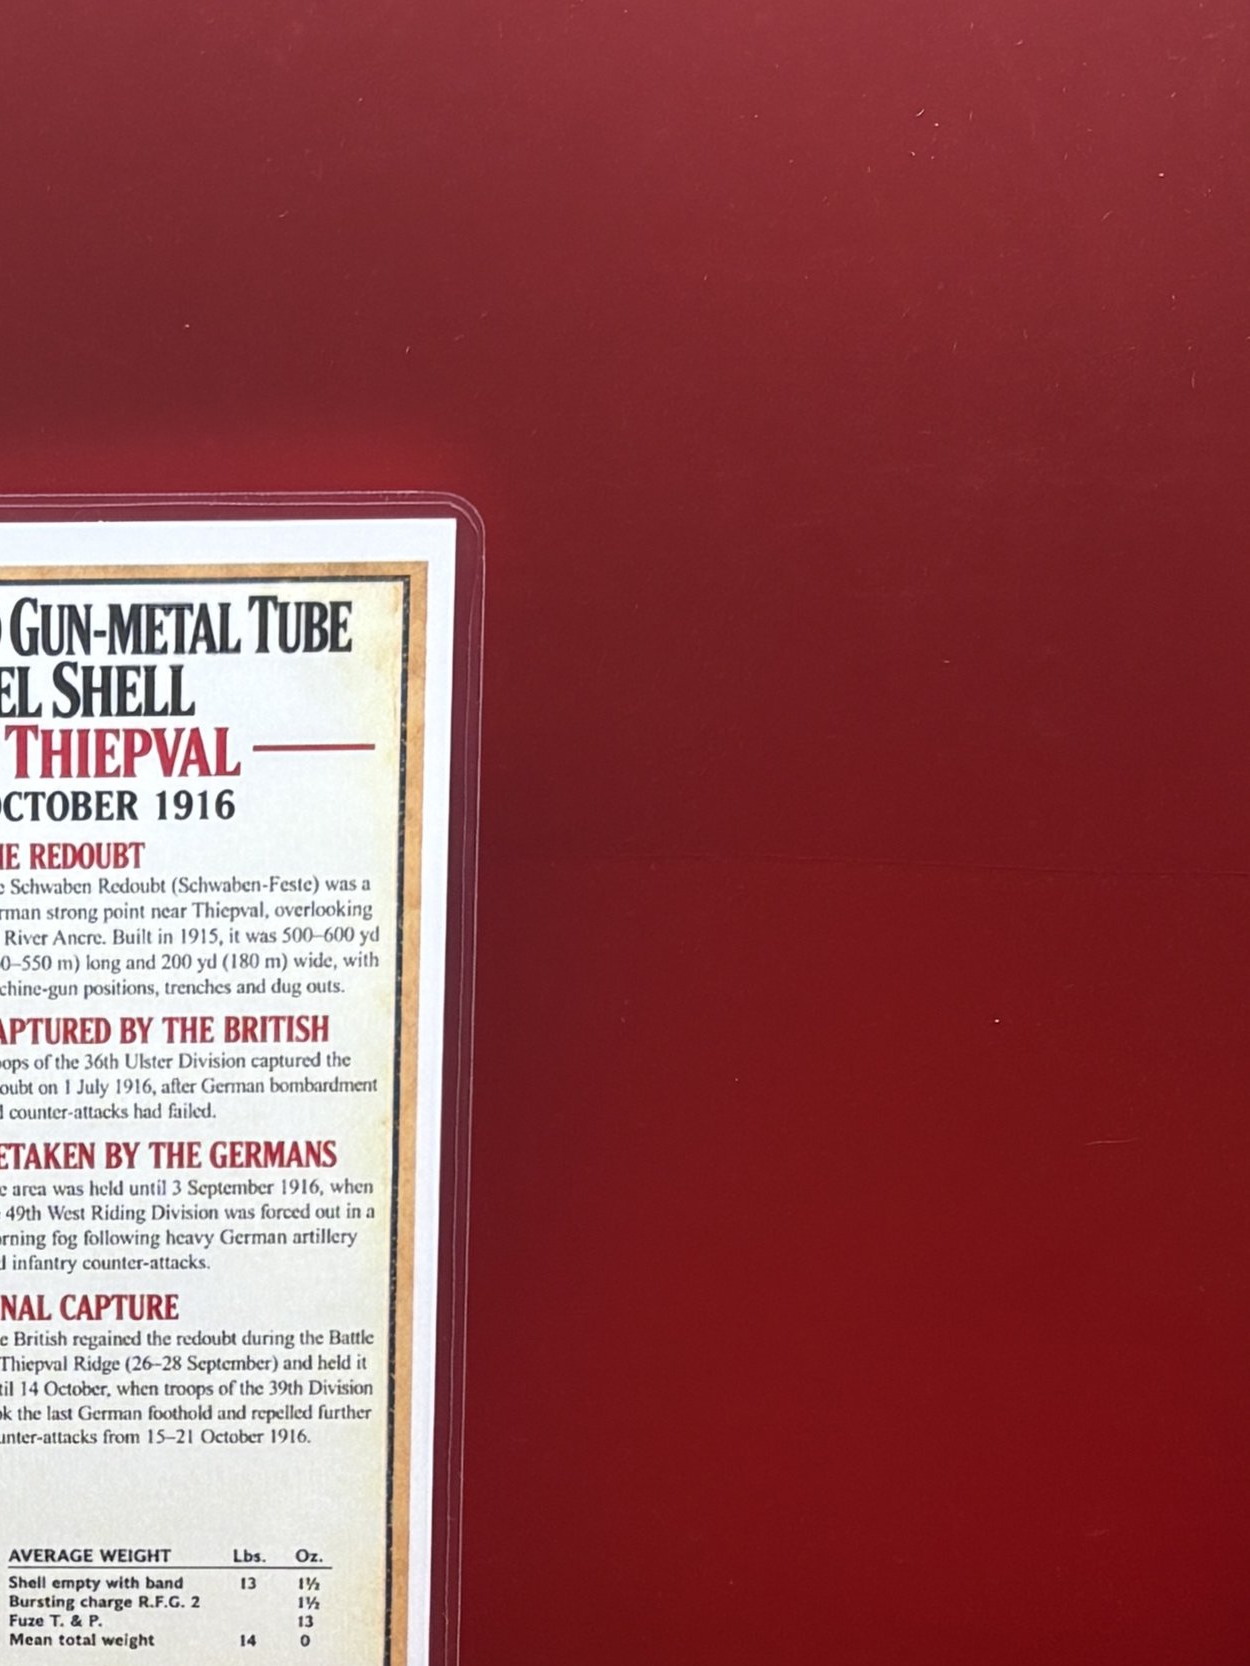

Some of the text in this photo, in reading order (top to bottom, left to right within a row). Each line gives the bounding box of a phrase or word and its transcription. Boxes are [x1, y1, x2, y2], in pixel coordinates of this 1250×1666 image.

[10, 595, 241, 656] GUN-METAL
[248, 594, 352, 653] TUBE
[52, 661, 195, 718] SHELL
[4, 724, 240, 778] THIEPVAL
[156, 789, 234, 820] 1916
[30, 842, 145, 869] REDOUBT
[10, 877, 91, 894] Schwaben
[98, 877, 165, 893] Redoubt
[172, 875, 319, 894] (Schwaben-Feste)
[325, 879, 356, 890] was
[361, 879, 370, 890] a
[46, 906, 97, 923] strong
[103, 902, 144, 923] point
[151, 906, 187, 918] near
[191, 901, 268, 922] Thiepval,
[274, 899, 372, 921] overlooking
[120, 1017, 153, 1043] BY
[162, 1016, 213, 1043] THE
[224, 1015, 328, 1042] BRITISH
[33, 1053, 52, 1069] of
[55, 1053, 79, 1069] the
[84, 1053, 118, 1069] 36th
[125, 1053, 172, 1069] Ulster
[179, 1052, 245, 1068] Division
[251, 1051, 320, 1072] captured
[326, 1051, 350, 1067] the
[105, 1142, 140, 1168] BY
[148, 1141, 201, 1168] THE
[209, 1140, 336, 1168] GERMANS
[12, 1185, 46, 1196] area
[52, 1185, 83, 1196] was
[89, 1180, 123, 1196] held
[129, 1179, 165, 1195] until
[172, 1179, 181, 1195] 3
[188, 1179, 274, 1199] September
[282, 1178, 323, 1195] 1916,
[330, 1177, 373, 1193] when
[60, 1293, 178, 1320] CAPTURE
[14, 1330, 67, 1346] British
[73, 1330, 141, 1350] regained
[147, 1330, 171, 1345] the
[176, 1330, 236, 1345] redoubt
[242, 1329, 294, 1349] during
[299, 1330, 323, 1344] the
[329, 1329, 374, 1344] Battle
[103, 1429, 139, 1443] from
[201, 1428, 264, 1443] October
[271, 1428, 310, 1443] 1916.
[8, 1548, 322, 1562] AVERAGE WEIGHT Lbs. Oz.
[9, 1575, 45, 1588] Shell
[52, 1578, 100, 1591] empty
[105, 1576, 138, 1588] with
[146, 1576, 183, 1588] band
[241, 1577, 256, 1589] 13
[9, 1595, 74, 1610] Bursting
[80, 1596, 132, 1611] charge
[138, 1595, 184, 1607] R.F.G.
[191, 1595, 199, 1607] 2
[9, 1614, 313, 1627] Fuze T. & P. 13
[10, 1633, 310, 1649] Mean total weight 14 0
